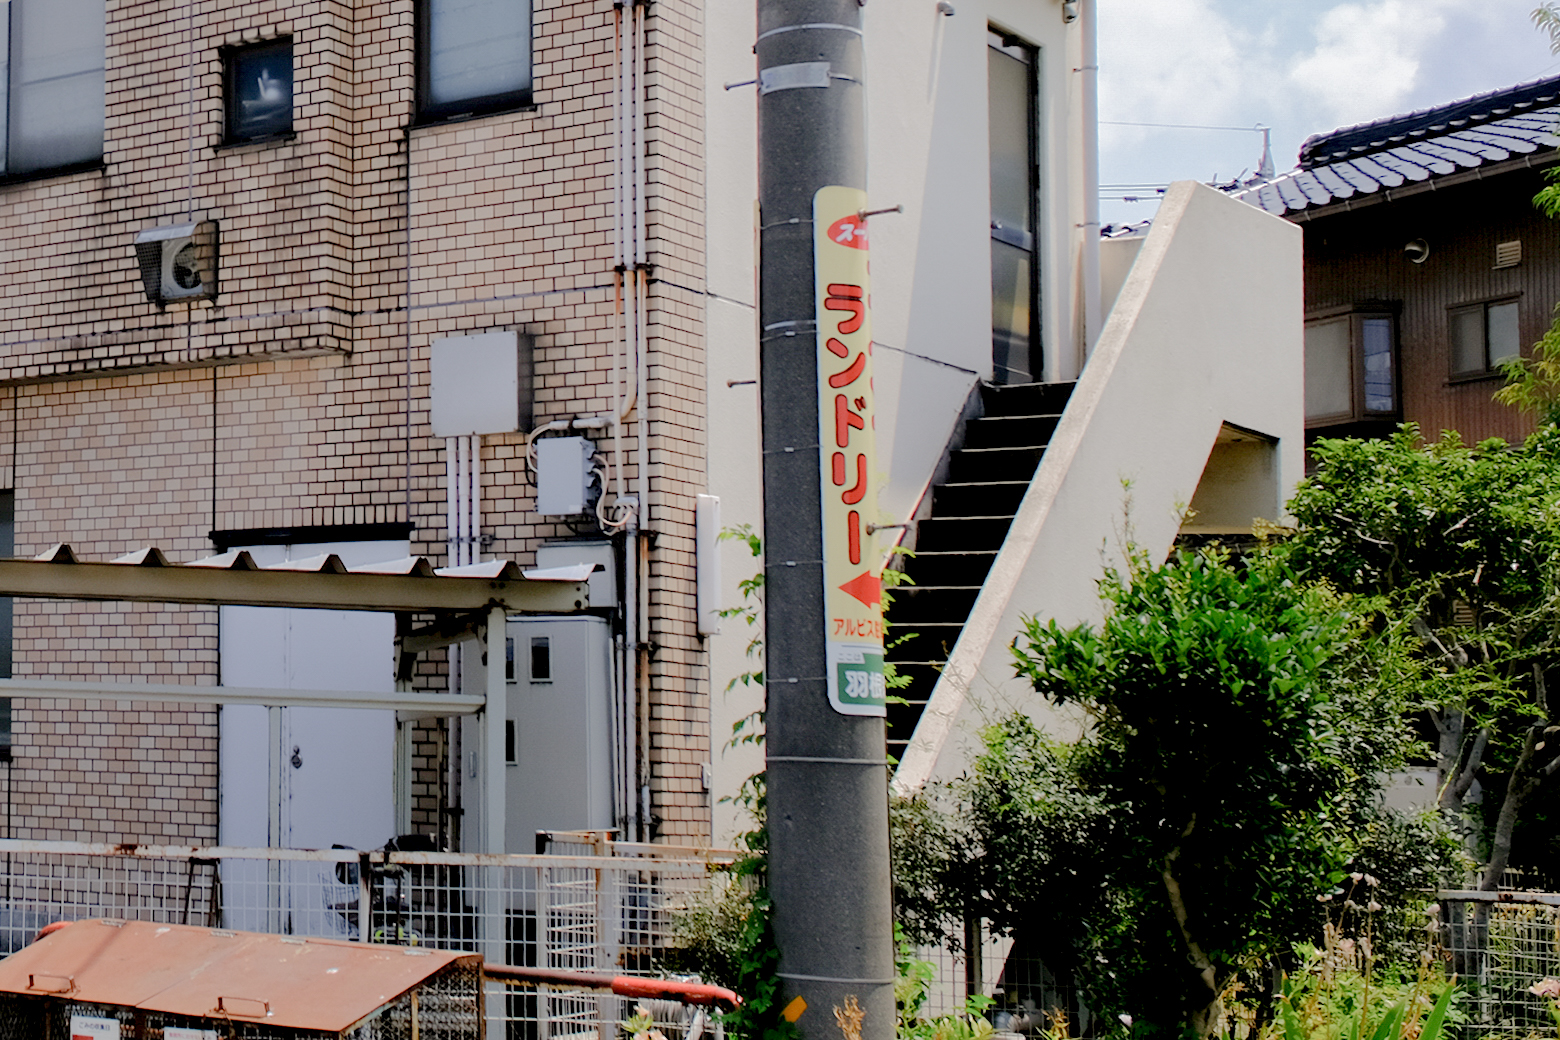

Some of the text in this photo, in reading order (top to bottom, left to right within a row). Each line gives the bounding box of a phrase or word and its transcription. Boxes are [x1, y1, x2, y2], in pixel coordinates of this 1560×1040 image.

[835, 223, 868, 243] スー
[824, 283, 868, 565] ランドリー
